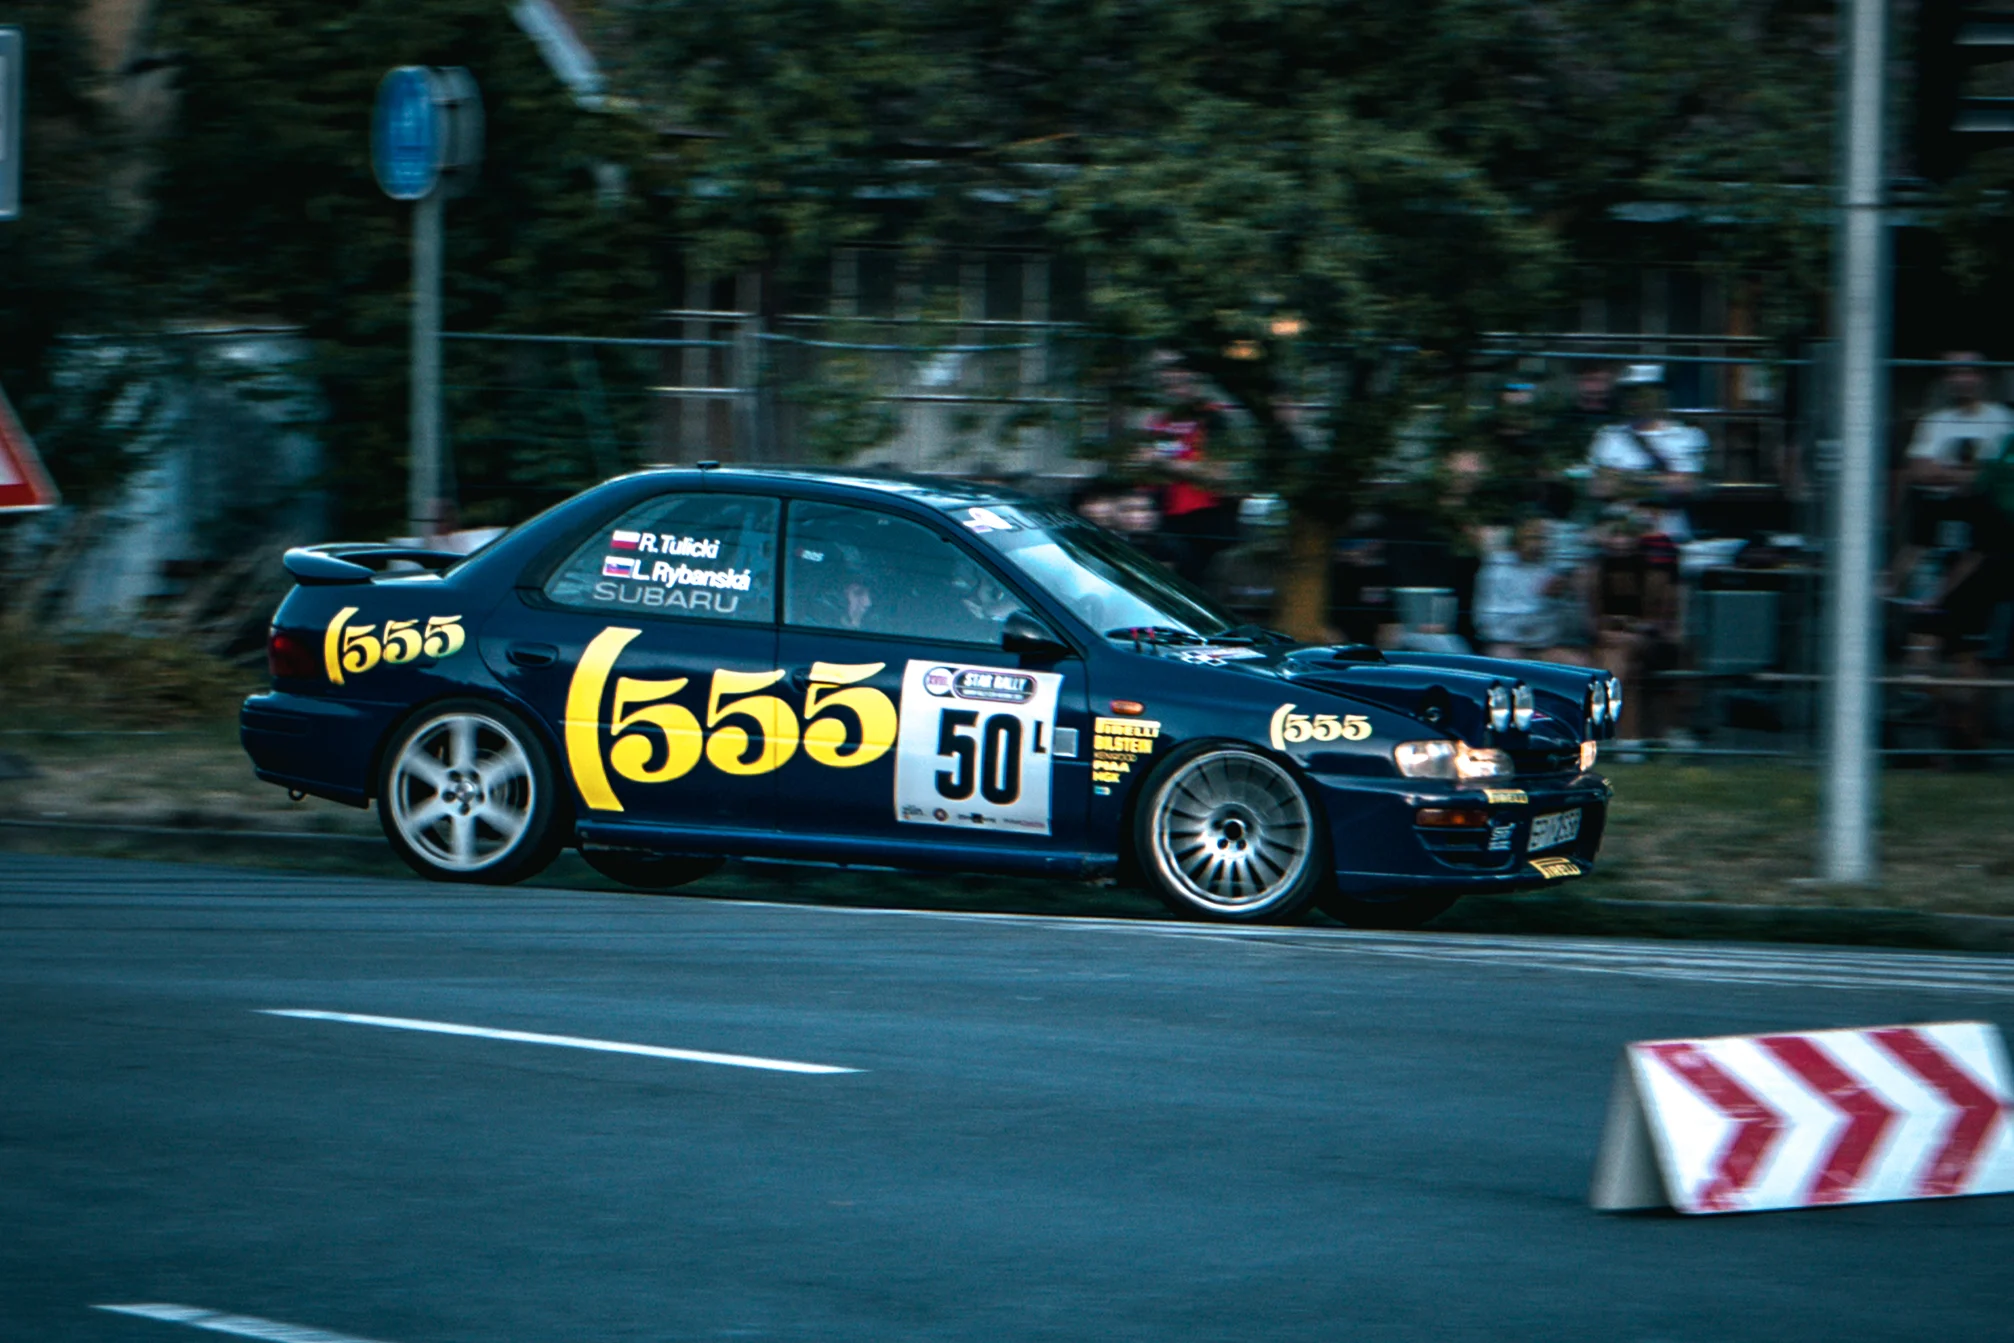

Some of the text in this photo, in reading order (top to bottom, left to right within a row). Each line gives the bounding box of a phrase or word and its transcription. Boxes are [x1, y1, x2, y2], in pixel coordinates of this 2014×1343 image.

[660, 534, 720, 559] Tulicki
[652, 561, 751, 591] Rybanská
[593, 582, 739, 613] SUBARU
[935, 707, 1047, 806] 50 L
[1528, 856, 1582, 879] PIRELLI
